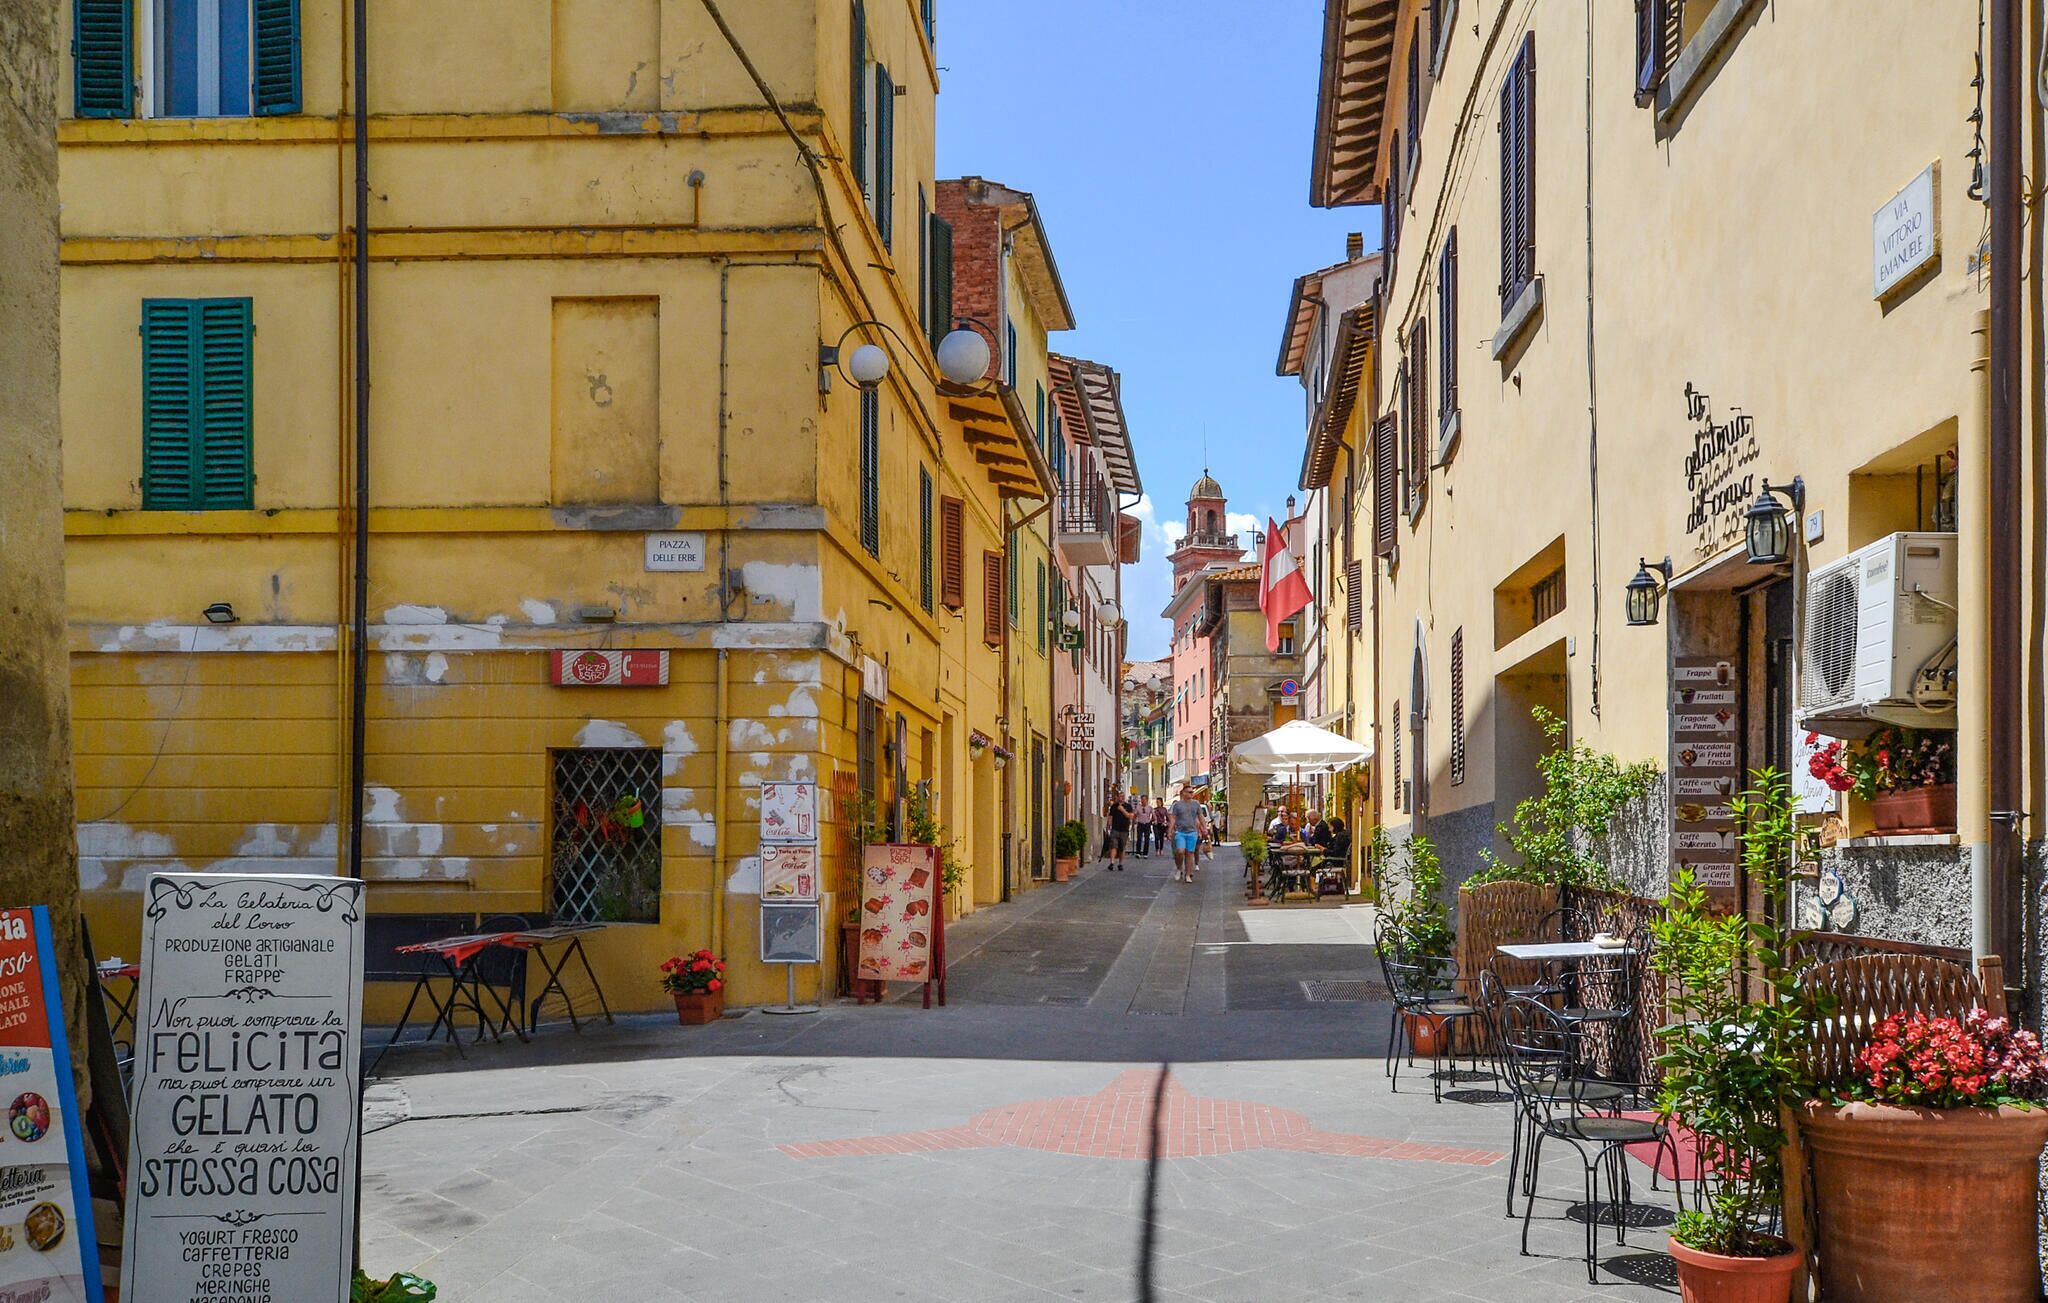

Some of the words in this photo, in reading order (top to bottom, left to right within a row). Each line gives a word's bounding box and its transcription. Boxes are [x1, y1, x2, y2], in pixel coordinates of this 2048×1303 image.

[1894, 199, 1909, 220] VIA
[1882, 211, 1922, 255] VITTORIO
[1880, 235, 1922, 281] EMANUELE
[1809, 516, 1818, 532] 79
[659, 540, 691, 549] PIAZZA
[652, 553, 675, 562] DELLE
[678, 553, 697, 562] ERBE
[1697, 693, 1724, 701] Frullati
[1072, 713, 1094, 723] IZZA
[1680, 715, 1708, 723] Fragole
[1072, 727, 1094, 737] PANE
[1071, 741, 1093, 750] DOLCI
[1707, 750, 1731, 758] Frutta
[1707, 758, 1731, 766] Fresca
[1679, 779, 1699, 787] Caffè
[1680, 832, 1699, 841] Caffè
[1710, 871, 1730, 880] Caffè
[199, 891, 227, 909] La
[237, 891, 314, 910] Gelateria
[211, 912, 240, 930] del
[245, 912, 295, 930] Corso
[151, 997, 193, 1029] Non
[196, 1013, 240, 1029] puoi
[243, 1013, 320, 1030] comprare
[321, 1010, 344, 1027] la
[158, 1077, 189, 1091] ma
[190, 1075, 228, 1092] puoi
[231, 1076, 303, 1093] comprare
[307, 1076, 336, 1088] un
[171, 1092, 319, 1136] GELATO
[163, 1139, 200, 1154] che
[234, 1140, 288, 1157] quasi
[292, 1138, 320, 1153] la
[179, 1230, 236, 1246] YOGURT
